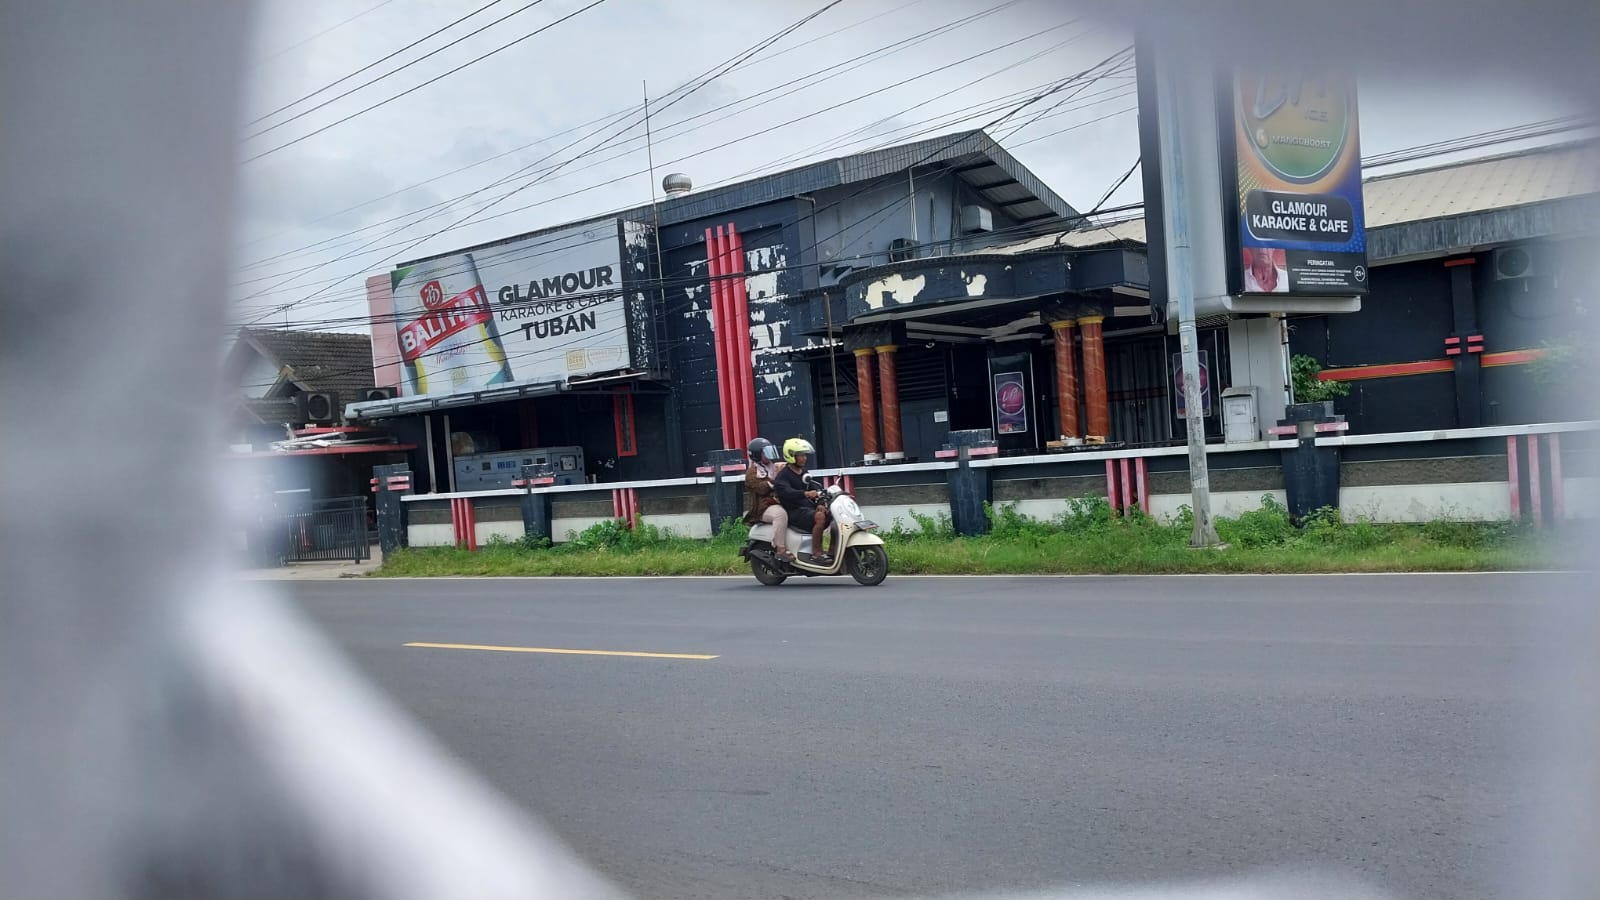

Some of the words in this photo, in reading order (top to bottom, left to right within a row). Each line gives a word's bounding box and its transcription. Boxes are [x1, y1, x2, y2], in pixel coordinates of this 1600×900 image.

[1271, 200, 1328, 217] GLAMOUR
[1252, 214, 1306, 231] KARAOKE
[1309, 218, 1317, 232] &
[1319, 219, 1349, 233] CAFE
[498, 265, 614, 304] GLAMOUR
[401, 313, 447, 353] BALI
[447, 291, 484, 327] HAI
[500, 301, 563, 321] KARAOKE
[565, 298, 576, 310] &
[521, 310, 597, 341] TUBAN
